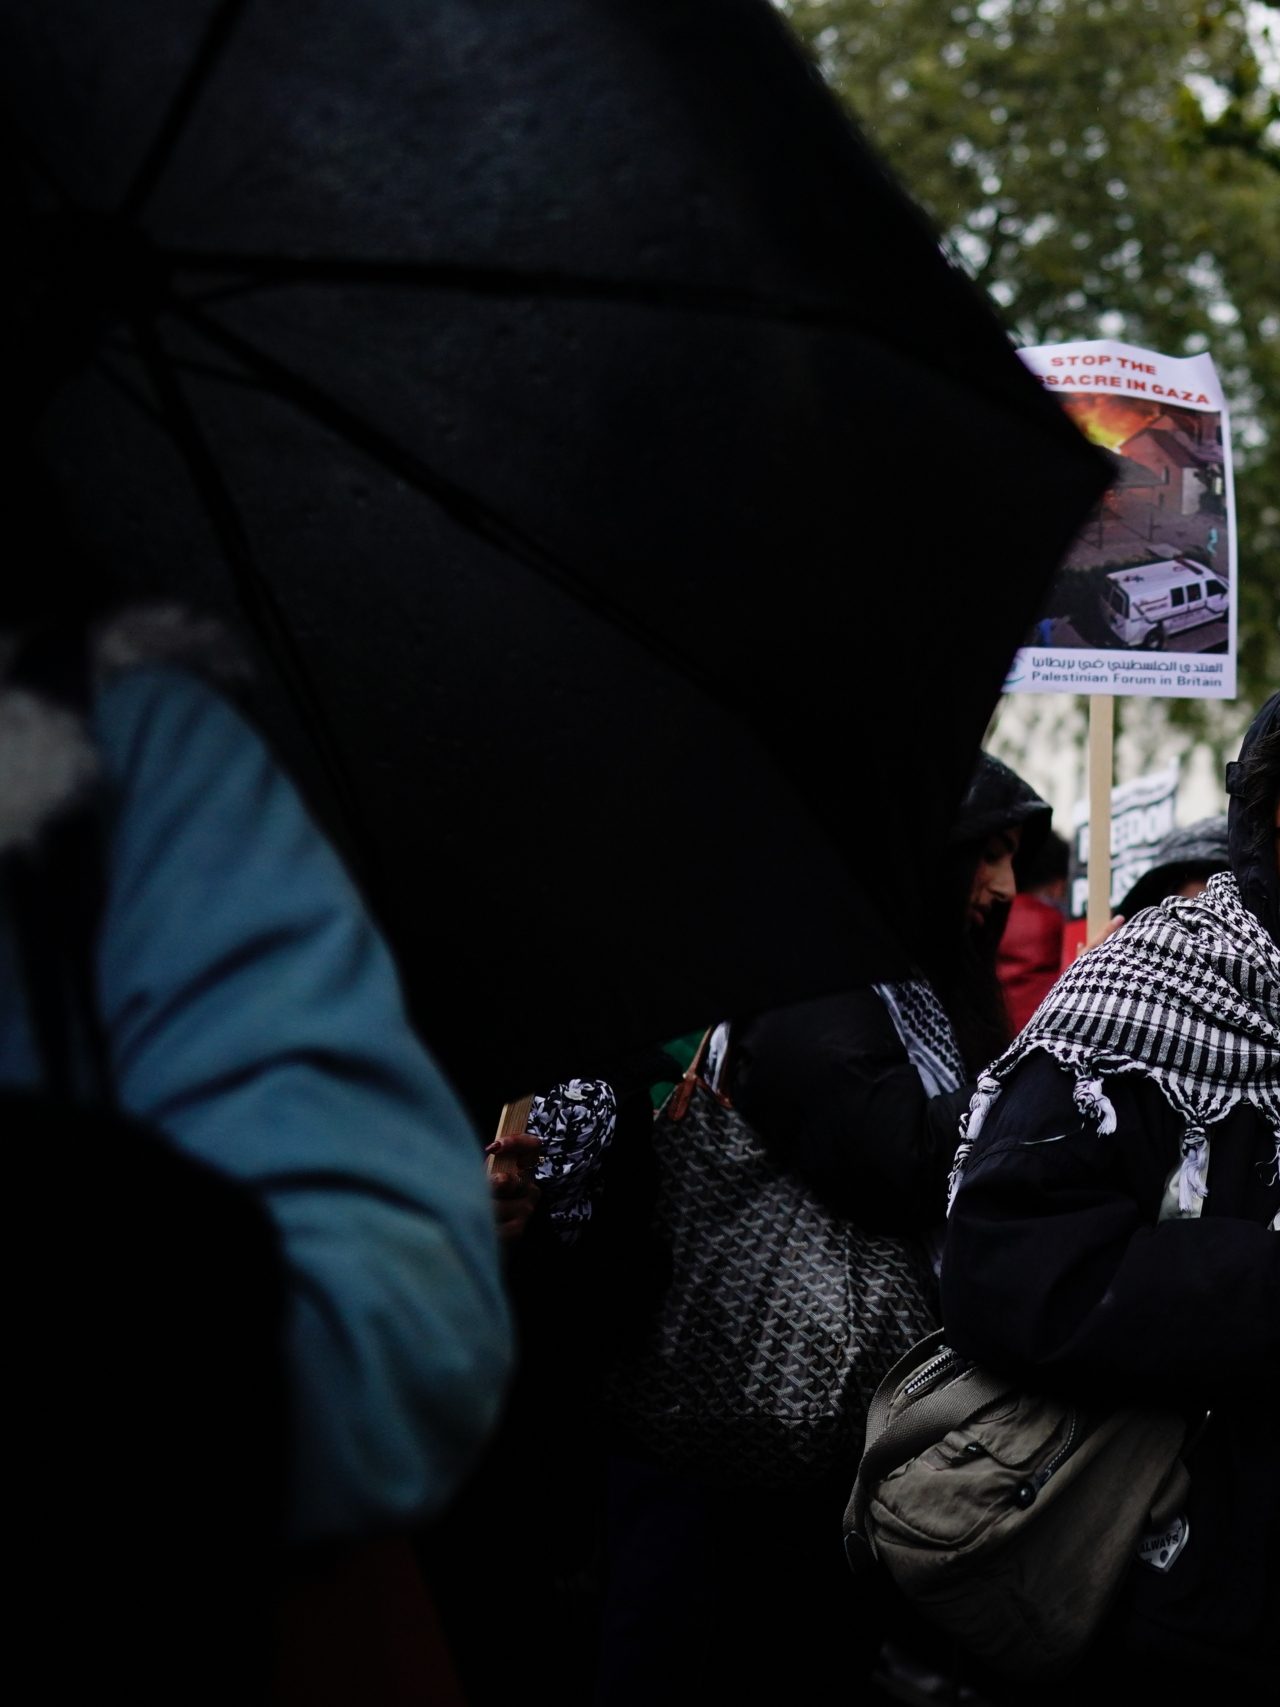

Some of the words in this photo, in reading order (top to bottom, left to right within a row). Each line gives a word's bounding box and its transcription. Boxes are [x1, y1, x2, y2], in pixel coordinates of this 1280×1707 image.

[1050, 355, 1112, 368] STOP
[1117, 357, 1157, 375] THE
[1127, 378, 1146, 391] IN
[1152, 383, 1211, 405] GAZA
[1031, 670, 1109, 684] Palestinian
[1113, 673, 1156, 686] Forum
[1159, 674, 1172, 686] in
[1176, 674, 1223, 688] Britain
